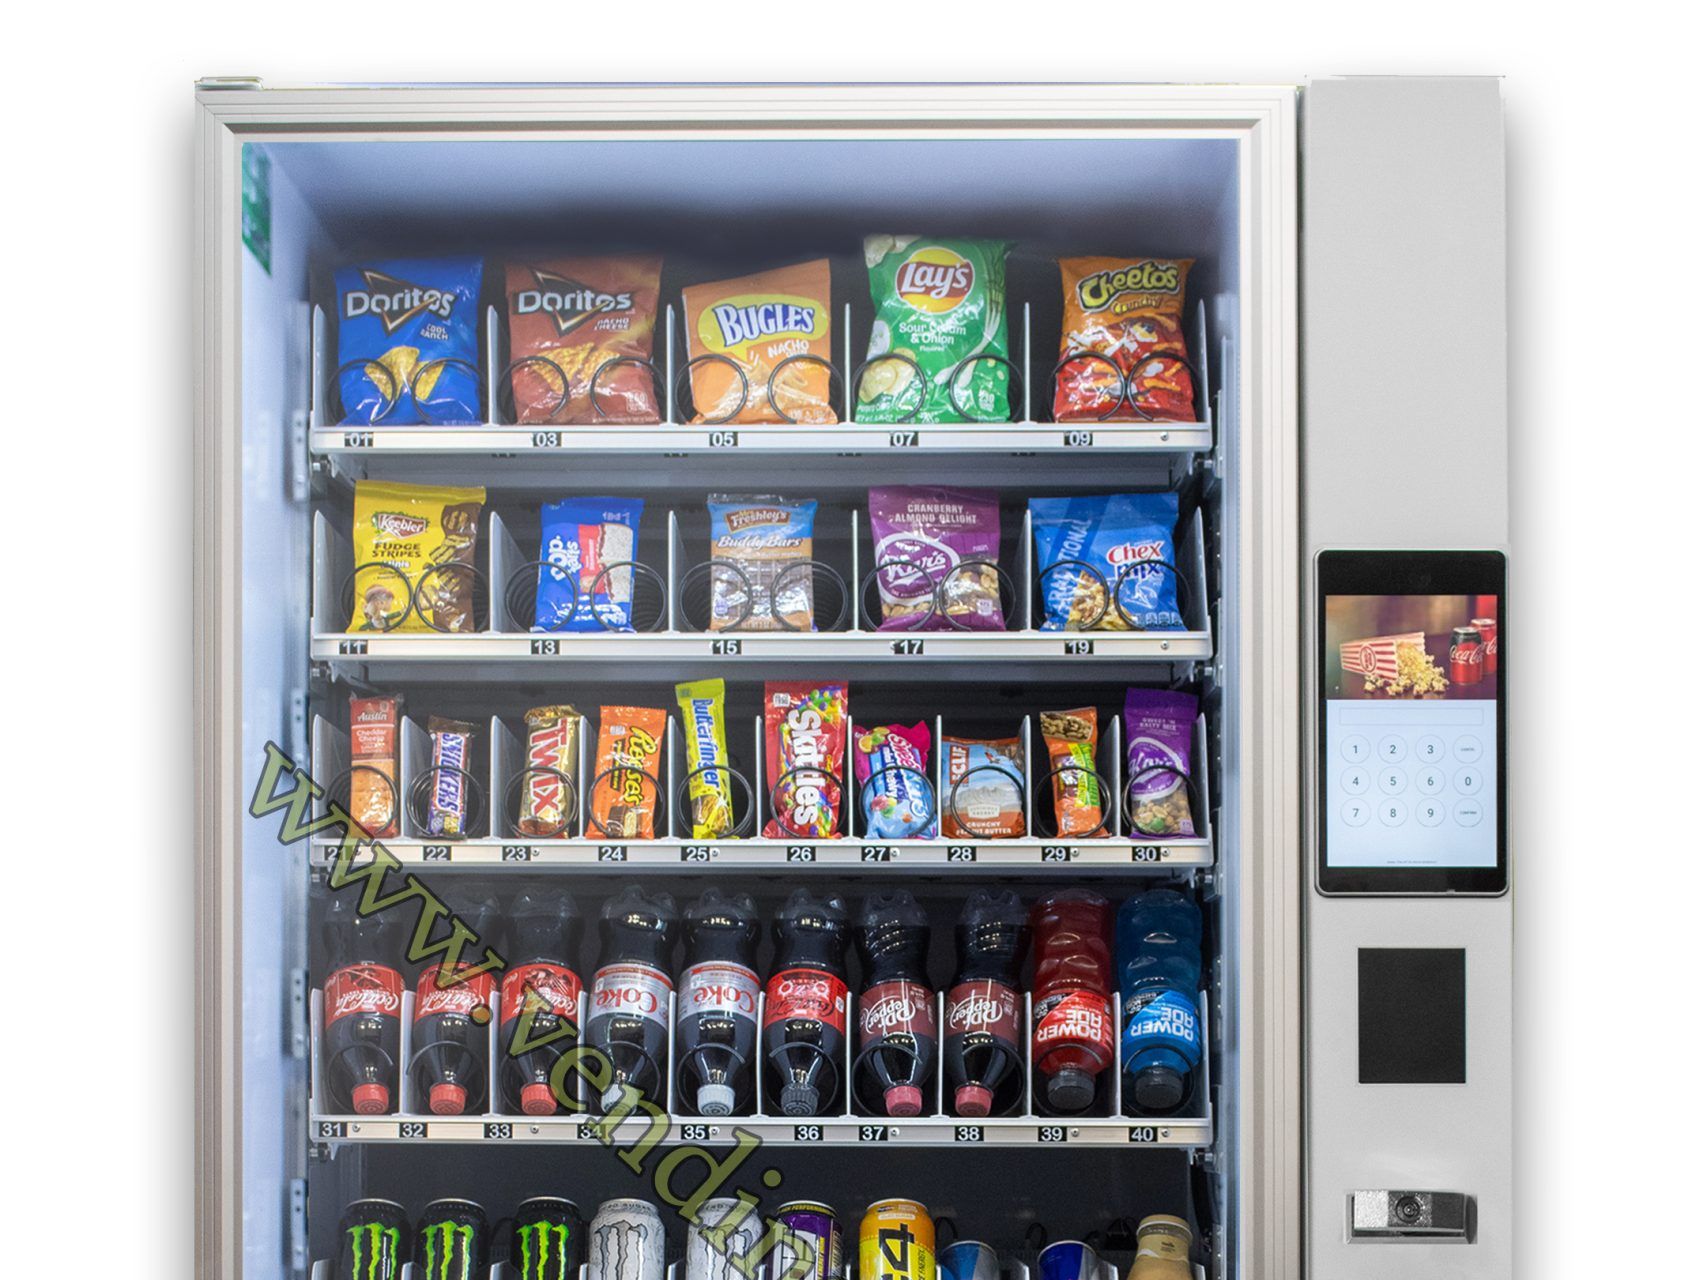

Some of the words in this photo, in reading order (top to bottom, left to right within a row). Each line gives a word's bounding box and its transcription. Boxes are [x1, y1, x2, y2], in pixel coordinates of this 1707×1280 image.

[900, 263, 969, 298] Lay's
[1079, 262, 1179, 309] Cheetos
[346, 287, 456, 317] Doritos
[518, 288, 632, 314] Doritos
[713, 304, 815, 346] BUGLES
[899, 321, 926, 334] Sour
[921, 332, 955, 344] Onion
[768, 339, 809, 358] NACHO
[349, 433, 371, 447] 01
[537, 433, 557, 447] 03
[713, 432, 734, 446] 05
[892, 433, 915, 447] 07
[1069, 432, 1090, 445] 09
[907, 504, 963, 513] CRANBERRY
[380, 514, 422, 534] Keebler
[895, 513, 935, 523] ALMOND
[374, 542, 421, 550] FUDGE
[717, 535, 764, 549] Buddy
[766, 535, 801, 548] Bars
[372, 550, 421, 558] STRIPES
[1108, 541, 1163, 563] Chex
[345, 641, 364, 653] 11
[534, 640, 556, 654] 13
[716, 641, 737, 654] 15
[901, 641, 922, 654] 17
[1069, 641, 1090, 654] 19
[357, 711, 387, 721] Austin
[692, 698, 720, 788] Butterfinger
[1352, 745, 1358, 754] 1
[1390, 745, 1396, 754] 2
[1427, 745, 1434, 754] 3
[436, 732, 464, 813] SNICKERS
[528, 718, 568, 817] TWIX
[624, 726, 657, 806] Reese's
[788, 710, 826, 825] Skittles
[1352, 777, 1359, 786] 4
[1390, 777, 1396, 786] 5
[1427, 777, 1434, 786] 6
[1465, 777, 1471, 786] 0
[1352, 808, 1359, 817] 7
[1390, 808, 1396, 818] 8
[1427, 808, 1434, 818] 9
[426, 847, 447, 861] 22
[505, 847, 526, 861] 23
[601, 848, 622, 861] 24
[687, 848, 707, 861] 25
[791, 848, 812, 861] 26
[865, 848, 886, 861] 27
[951, 848, 972, 861] 28
[1045, 848, 1066, 861] 29
[1135, 848, 1157, 861] 30
[596, 986, 657, 1014] Coke
[693, 986, 755, 1014] Coke
[1066, 1006, 1102, 1024] ADE
[1161, 1006, 1194, 1023] ADE
[1037, 1022, 1102, 1042] POWER
[1131, 1021, 1194, 1039] POWER
[322, 1123, 342, 1137] 31
[402, 1123, 424, 1137] 32
[489, 1124, 511, 1138] 33
[684, 1126, 705, 1140] 35
[798, 1127, 819, 1140] 36
[862, 1127, 884, 1141] 37
[958, 1127, 979, 1141] 38
[1042, 1127, 1063, 1141] 39
[1131, 1128, 1154, 1142] 40
